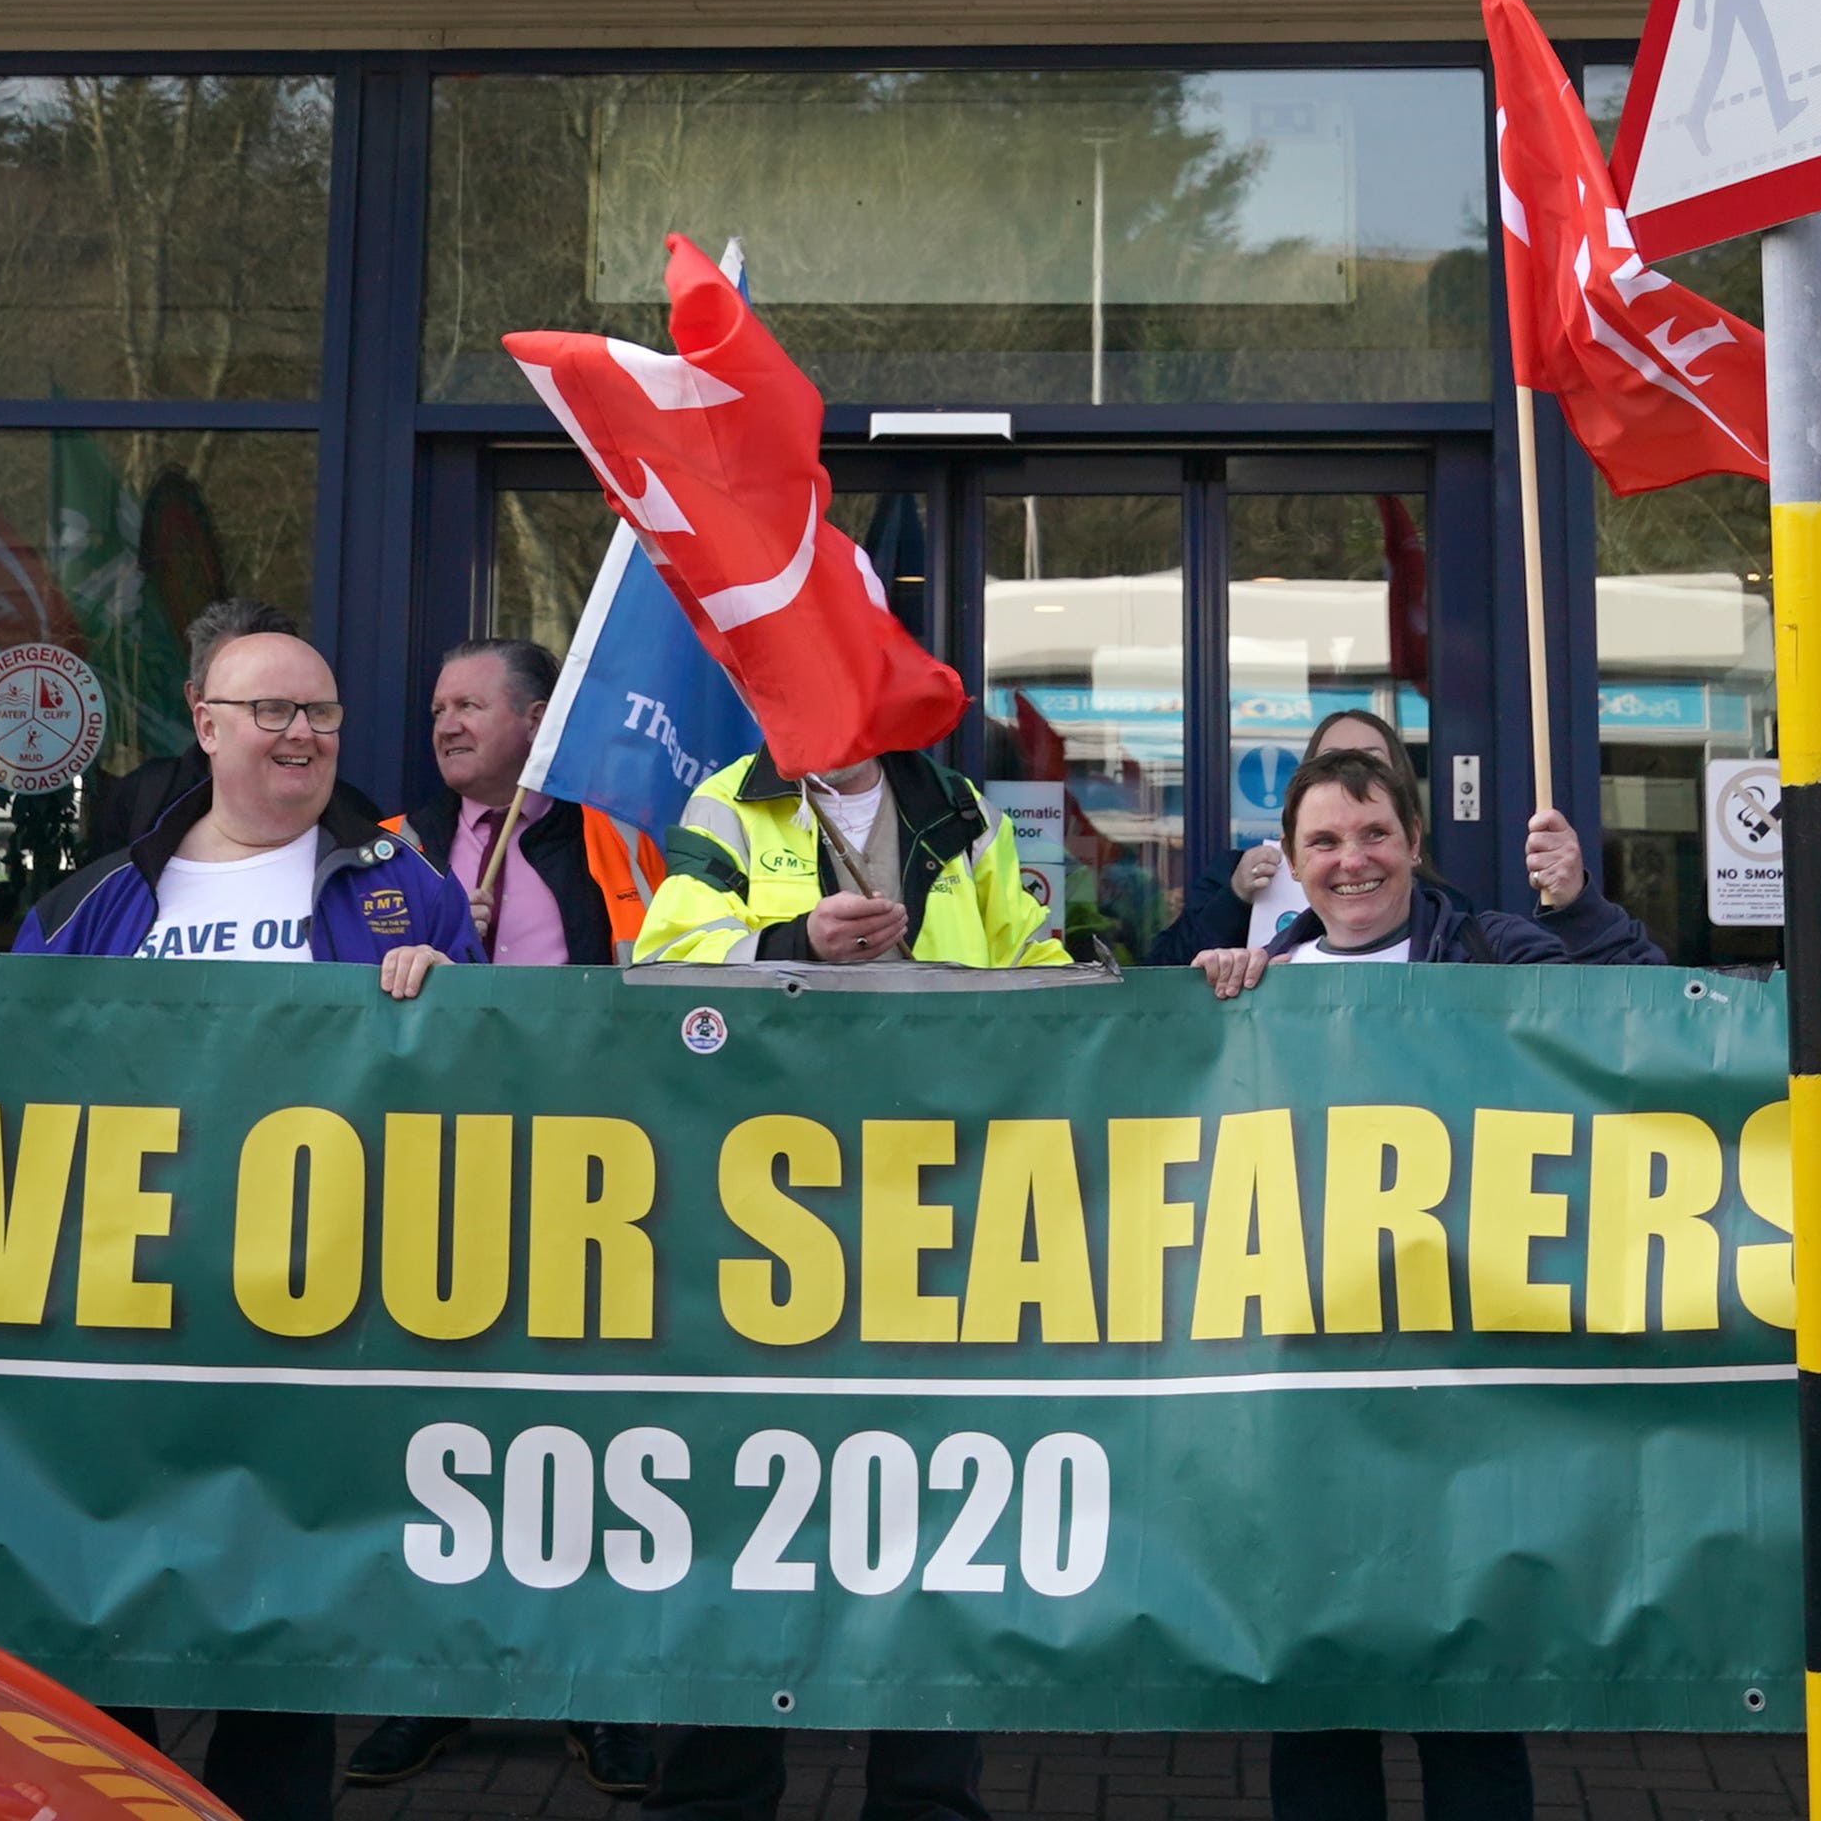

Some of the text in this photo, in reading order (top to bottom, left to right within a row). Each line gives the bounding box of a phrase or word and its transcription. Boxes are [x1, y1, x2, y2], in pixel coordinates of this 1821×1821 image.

[43, 710, 71, 720] CLIFF
[12, 712, 102, 790] COASTGUARD
[19, 753, 44, 762] MUD
[1002, 806, 1062, 819] tomatic
[1717, 869, 1738, 879] NO
[364, 897, 404, 910] RMT
[139, 921, 237, 958] SAVE
[233, 1106, 655, 1342] OUR
[403, 1422, 1111, 1598] SOS 2020
